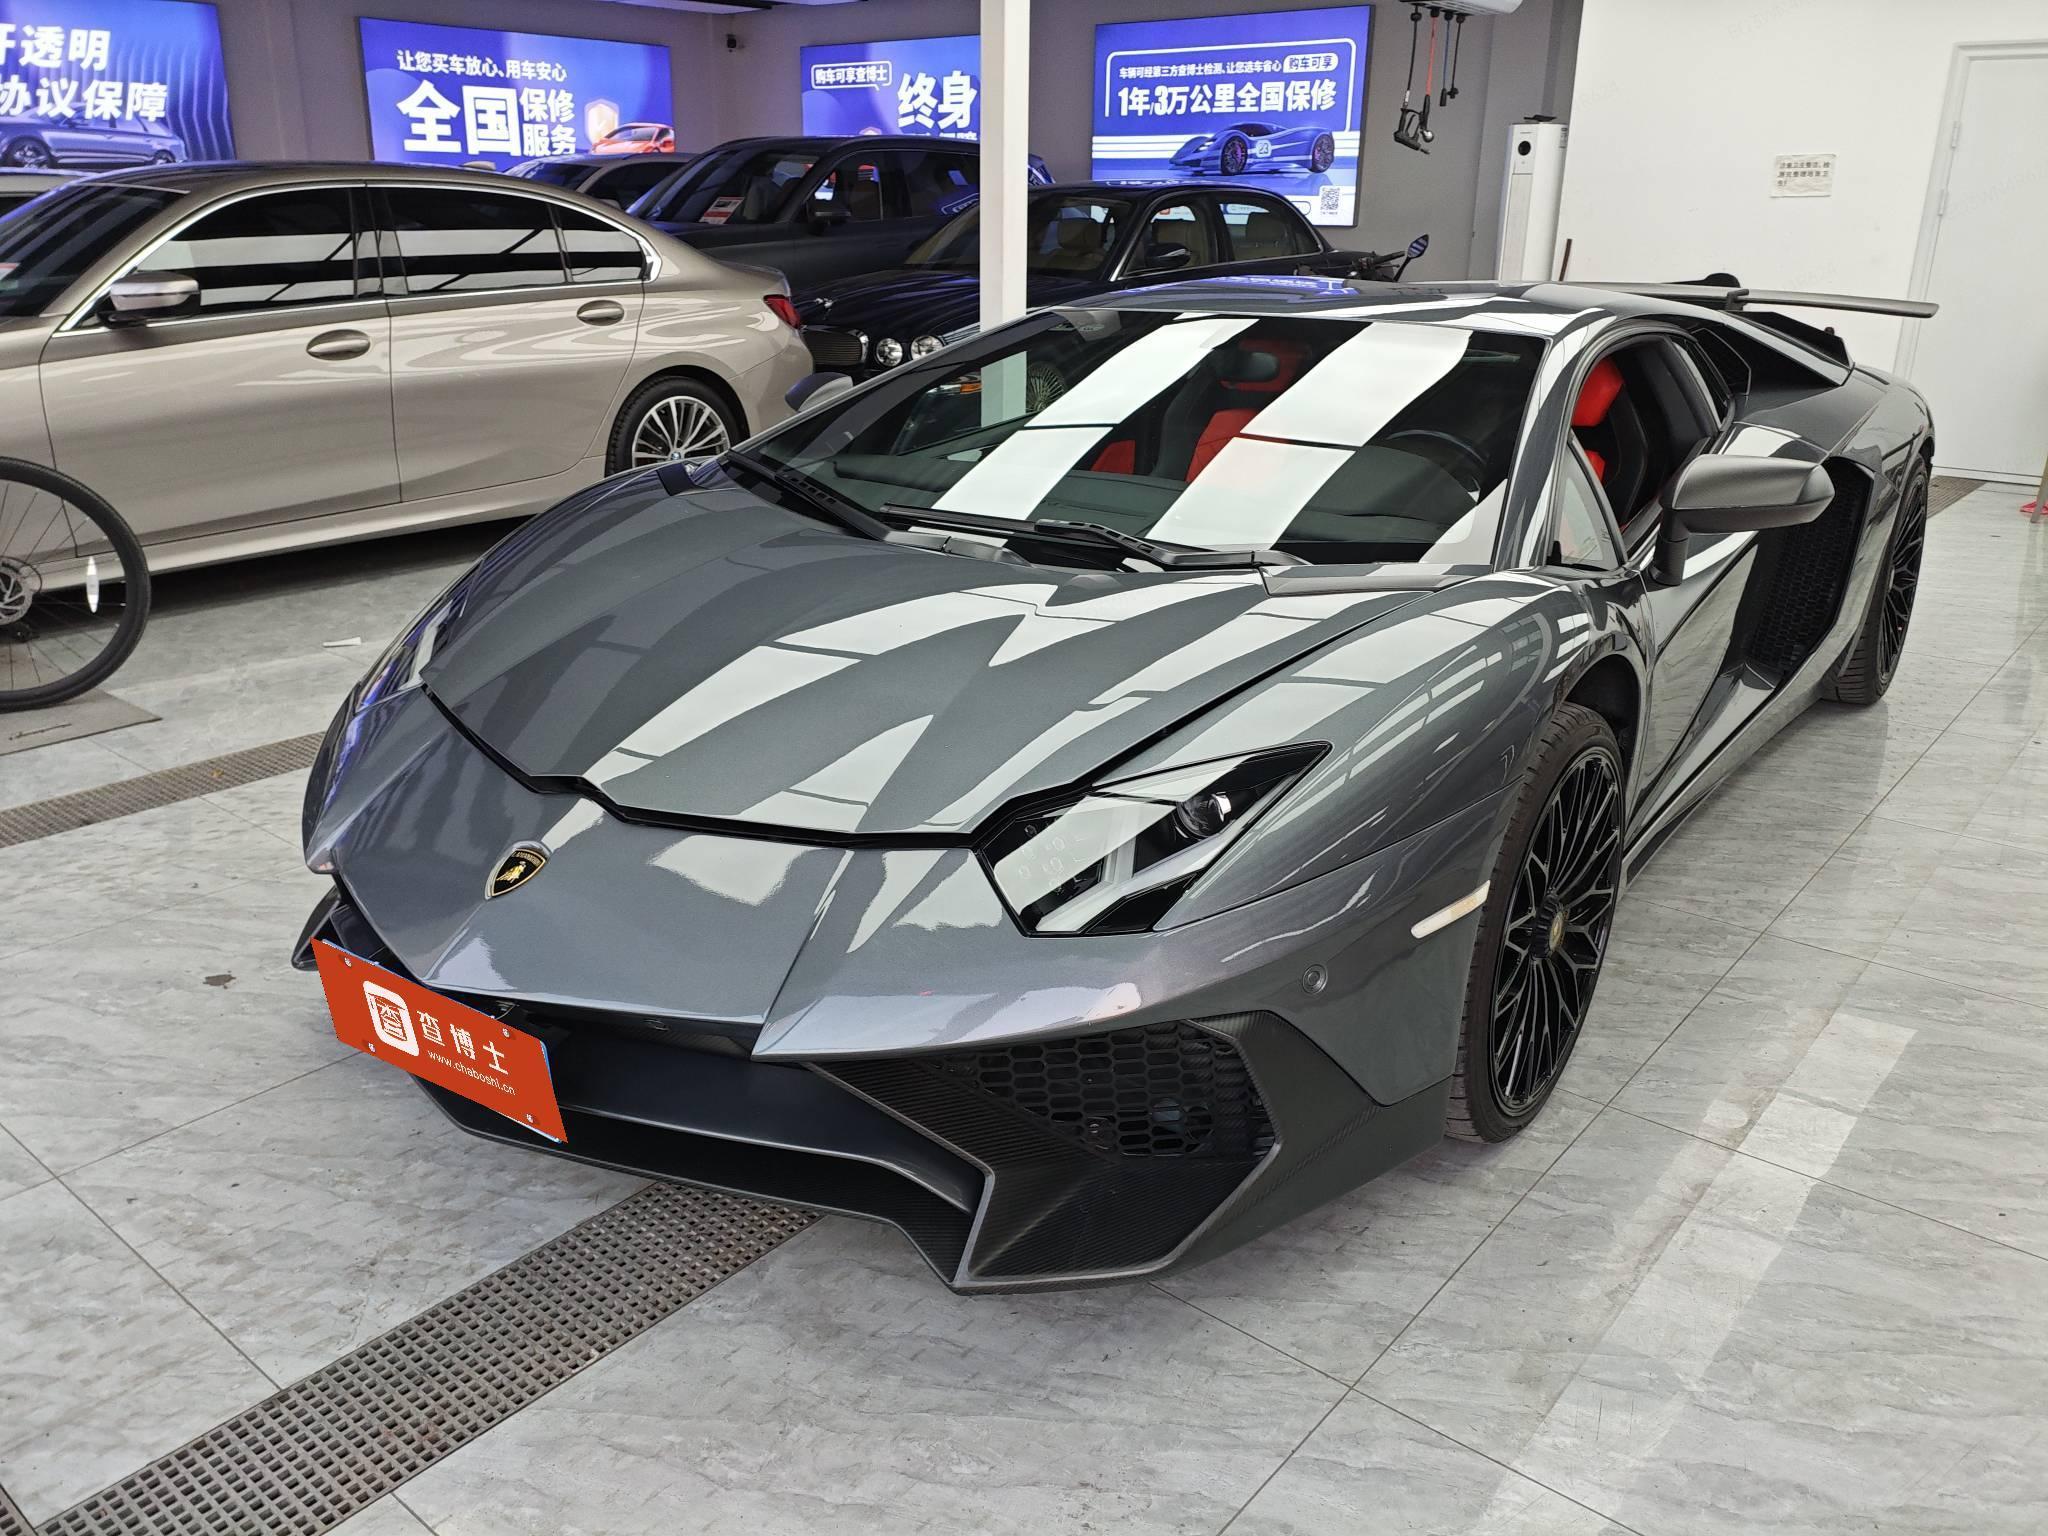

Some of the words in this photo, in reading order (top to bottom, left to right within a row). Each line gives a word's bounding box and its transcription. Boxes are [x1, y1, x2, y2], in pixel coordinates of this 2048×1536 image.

[396, 49, 568, 82] 让您买车放心、用车安心
[815, 64, 888, 85] 购车可享查博士
[1288, 55, 1333, 70] 购车可享
[0, 74, 168, 122] 协议保障
[519, 87, 575, 123] 保修
[897, 70, 978, 130] 终身
[396, 79, 522, 156] 全国
[522, 123, 577, 157] 服务
